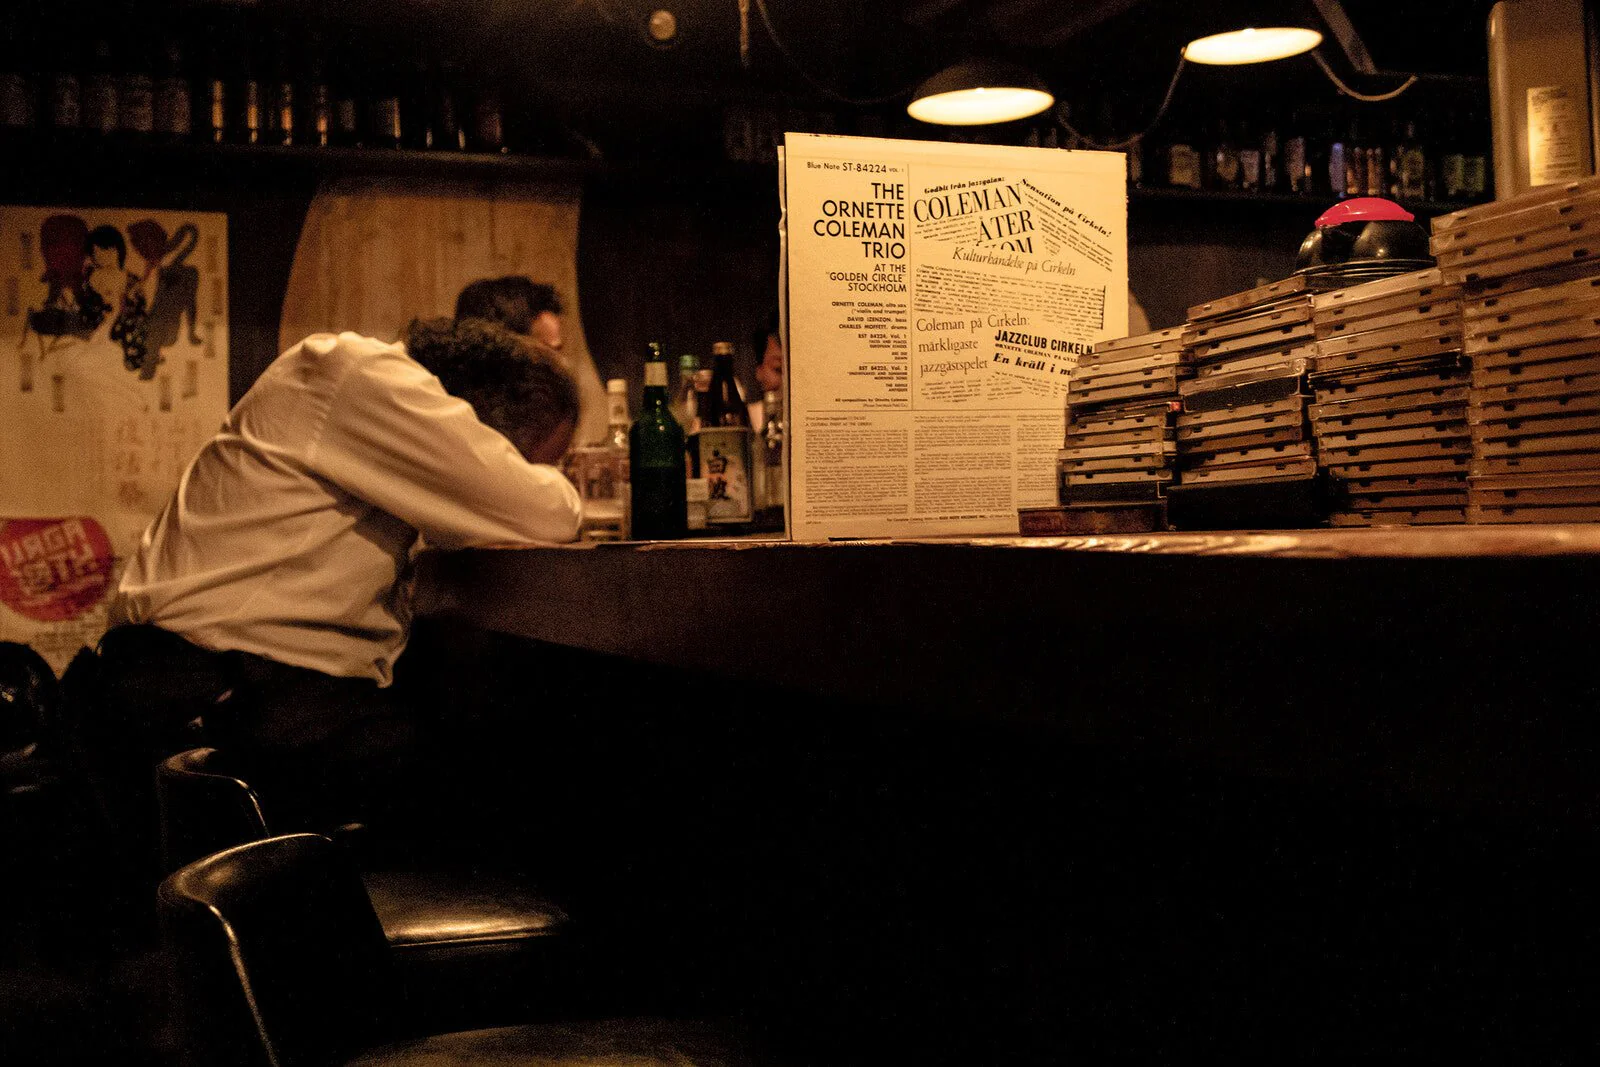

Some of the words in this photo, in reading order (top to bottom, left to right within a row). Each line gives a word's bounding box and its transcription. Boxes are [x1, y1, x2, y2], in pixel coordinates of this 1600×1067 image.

[842, 162, 887, 173] ST-84224
[871, 182, 904, 200] THE
[1022, 178, 1060, 207] Sensation
[822, 200, 904, 220] ORNETTE
[913, 183, 1022, 223] COLEMAN
[813, 220, 905, 240] COLEMAN
[978, 209, 1035, 241] ÅTER
[861, 241, 906, 260] TRIO
[874, 264, 886, 272] AT
[890, 264, 906, 273] THE
[848, 282, 907, 293] STOCKHOLM
[916, 317, 964, 332] Coleman
[970, 318, 983, 334] på
[987, 312, 1030, 328] Cirkeln:
[994, 329, 1048, 349] JAZZCLUB
[1050, 339, 1093, 356] CIRKELN
[992, 352, 1010, 364] En
[1050, 363, 1056, 373] i
[1024, 348, 1052, 358] COLEMAN
